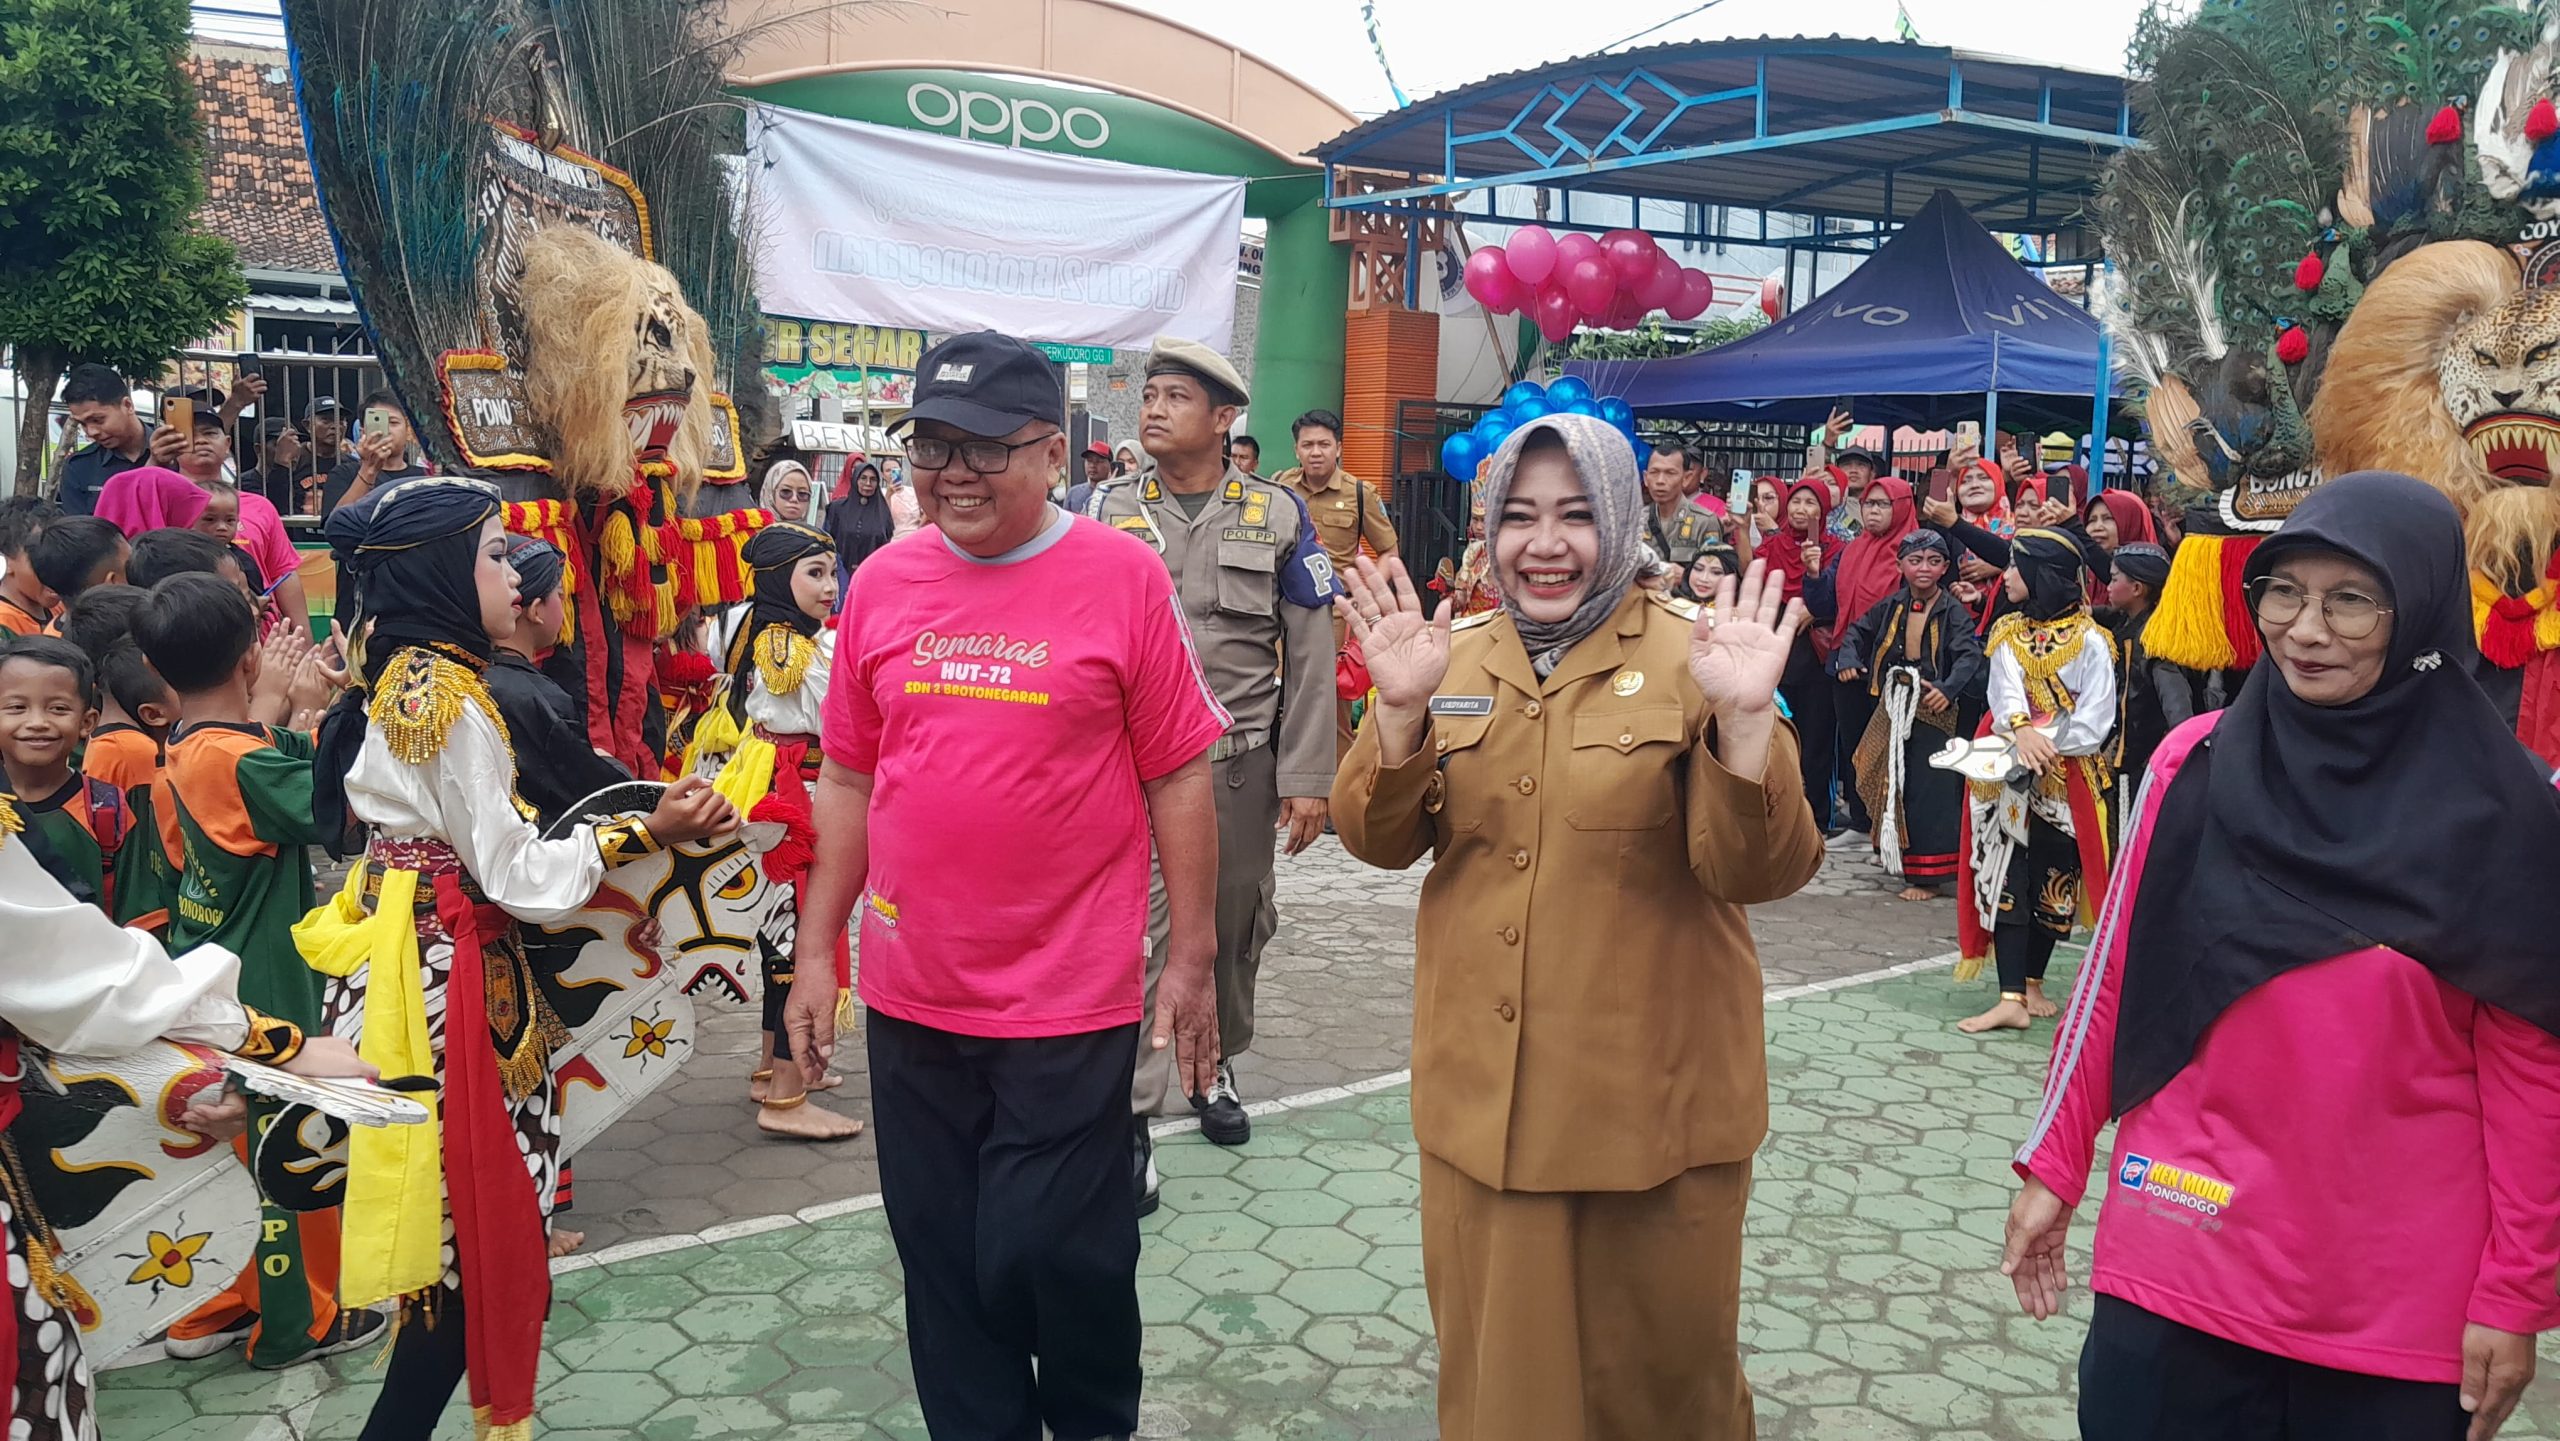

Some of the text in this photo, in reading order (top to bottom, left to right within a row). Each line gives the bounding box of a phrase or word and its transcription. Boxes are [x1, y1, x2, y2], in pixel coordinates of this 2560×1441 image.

[907, 83, 1110, 149] oppo
[809, 322, 924, 370] SEGAR
[472, 398, 512, 427] PONO
[801, 424, 906, 452] BENSIN
[1226, 530, 1272, 541] POL PP
[1303, 553, 1333, 597] P
[912, 631, 1049, 668] Semarak
[940, 661, 1011, 684] HUT-72
[904, 681, 1049, 705] SDN 2 BROTONEGARAN
[2144, 1182, 2218, 1216] PONOROGO
[2149, 1162, 2234, 1206] HEN MODE
